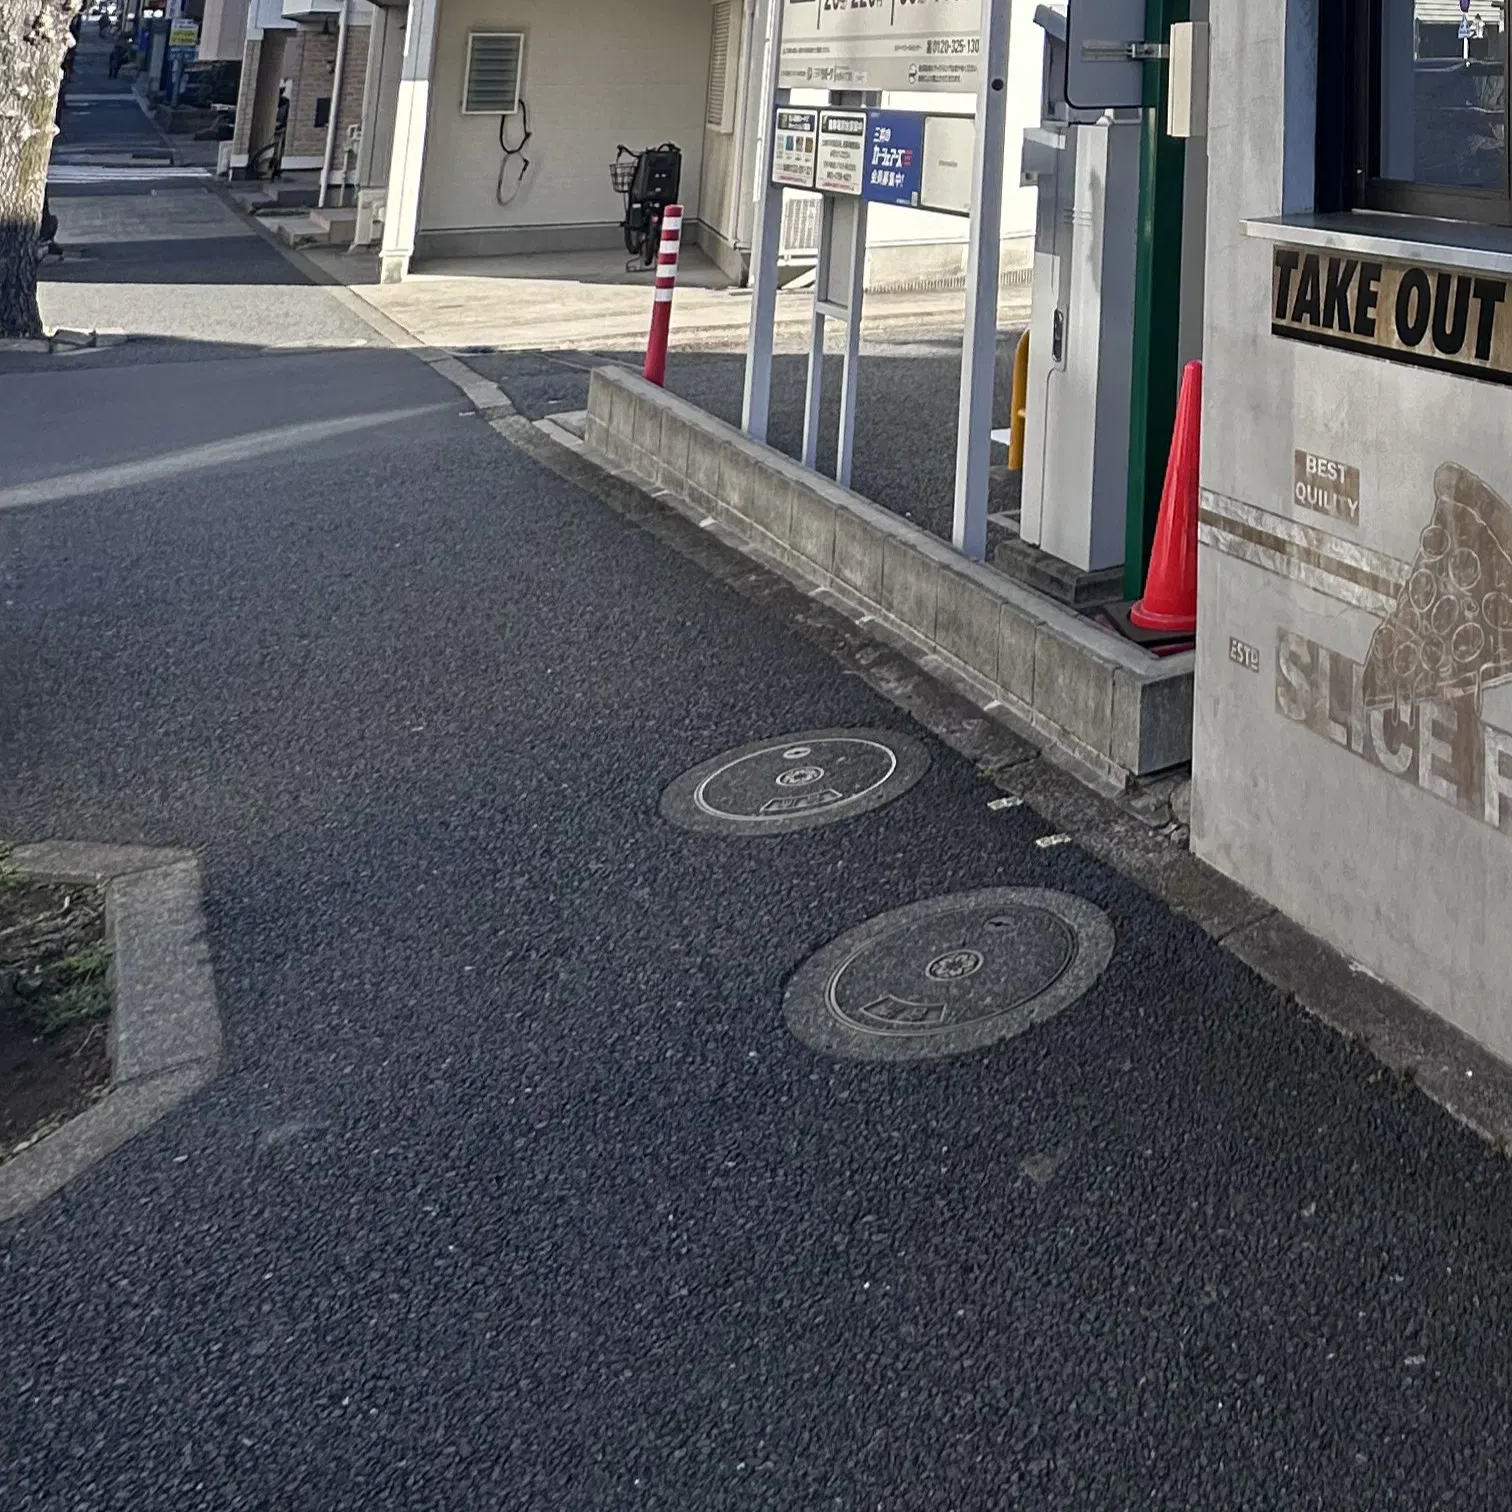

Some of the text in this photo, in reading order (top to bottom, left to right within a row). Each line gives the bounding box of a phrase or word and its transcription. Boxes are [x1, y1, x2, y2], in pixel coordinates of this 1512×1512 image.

[1275, 249, 1383, 338] TAKE
[1395, 267, 1506, 361] OUT
[1306, 454, 1346, 484] BEST
[1276, 632, 1460, 804] SLICE
